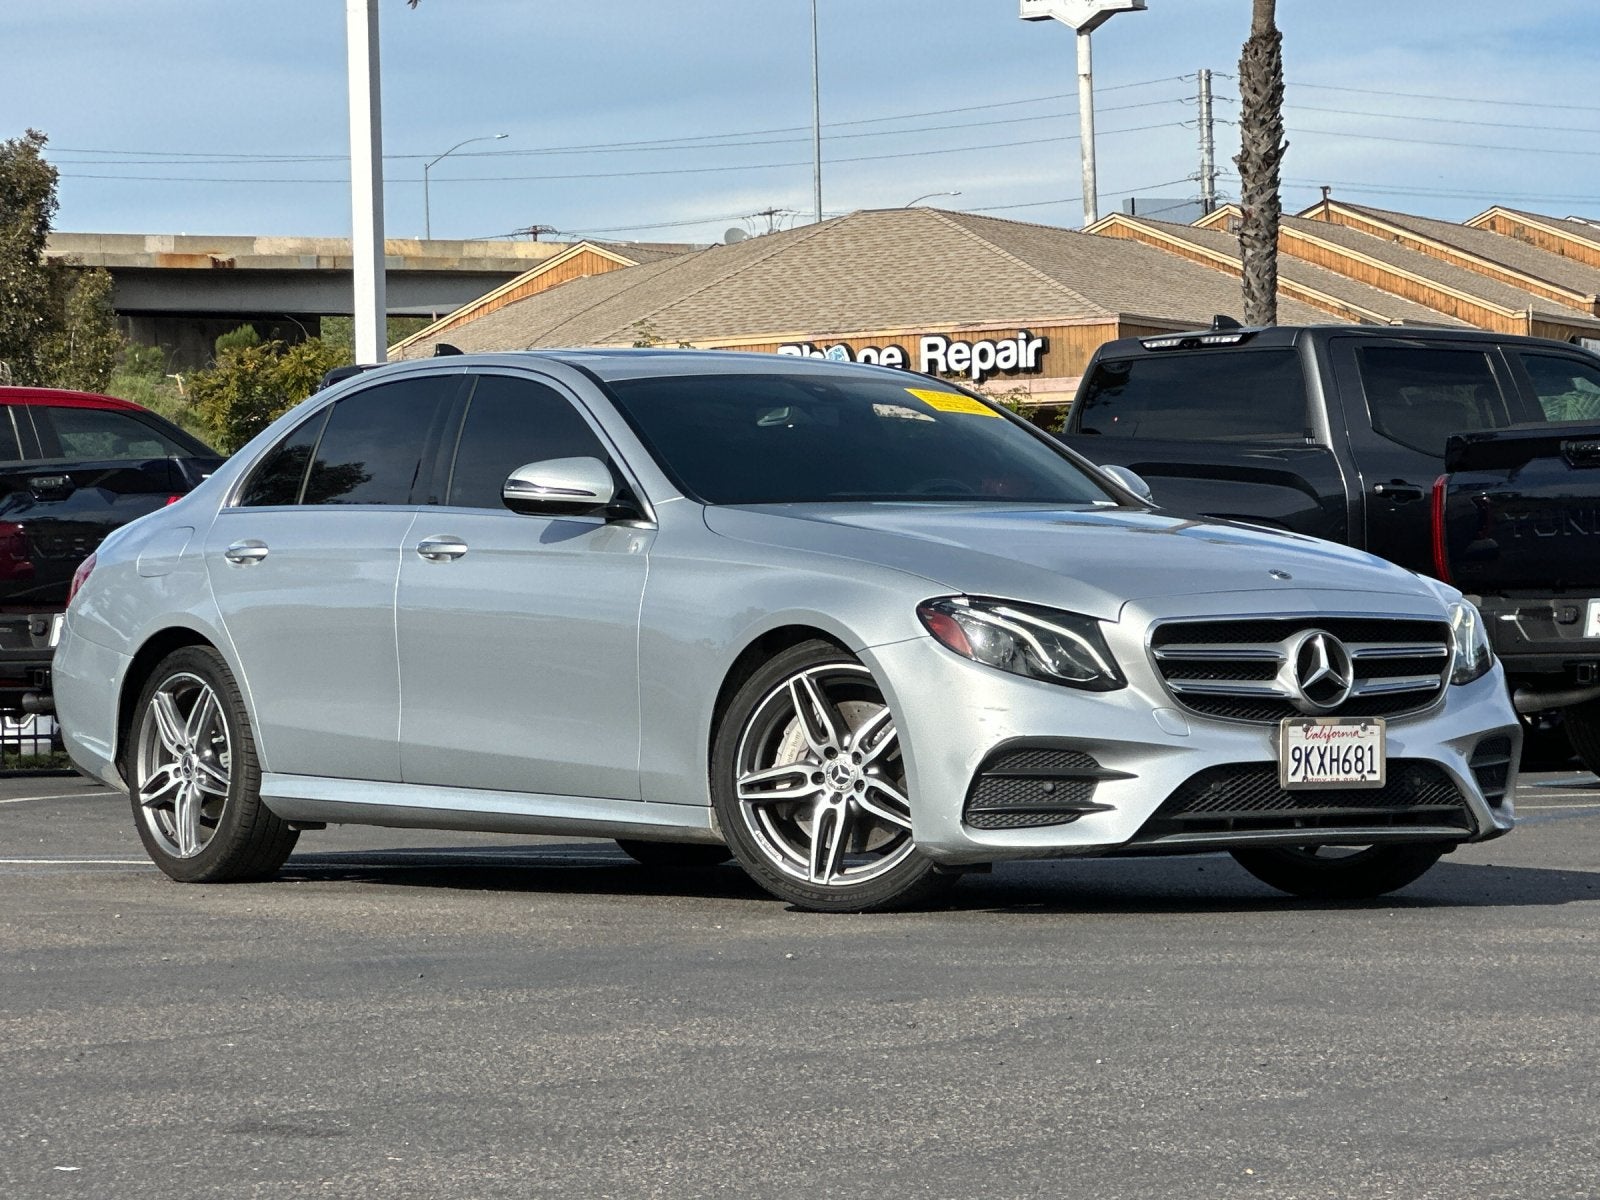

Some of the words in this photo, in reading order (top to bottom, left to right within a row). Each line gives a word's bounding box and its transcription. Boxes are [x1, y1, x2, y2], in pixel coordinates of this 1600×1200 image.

[920, 332, 1043, 380] Repair
[1503, 509, 1600, 539] TUN
[1304, 725, 1365, 744] California
[1291, 745, 1377, 776] 9KXH681
